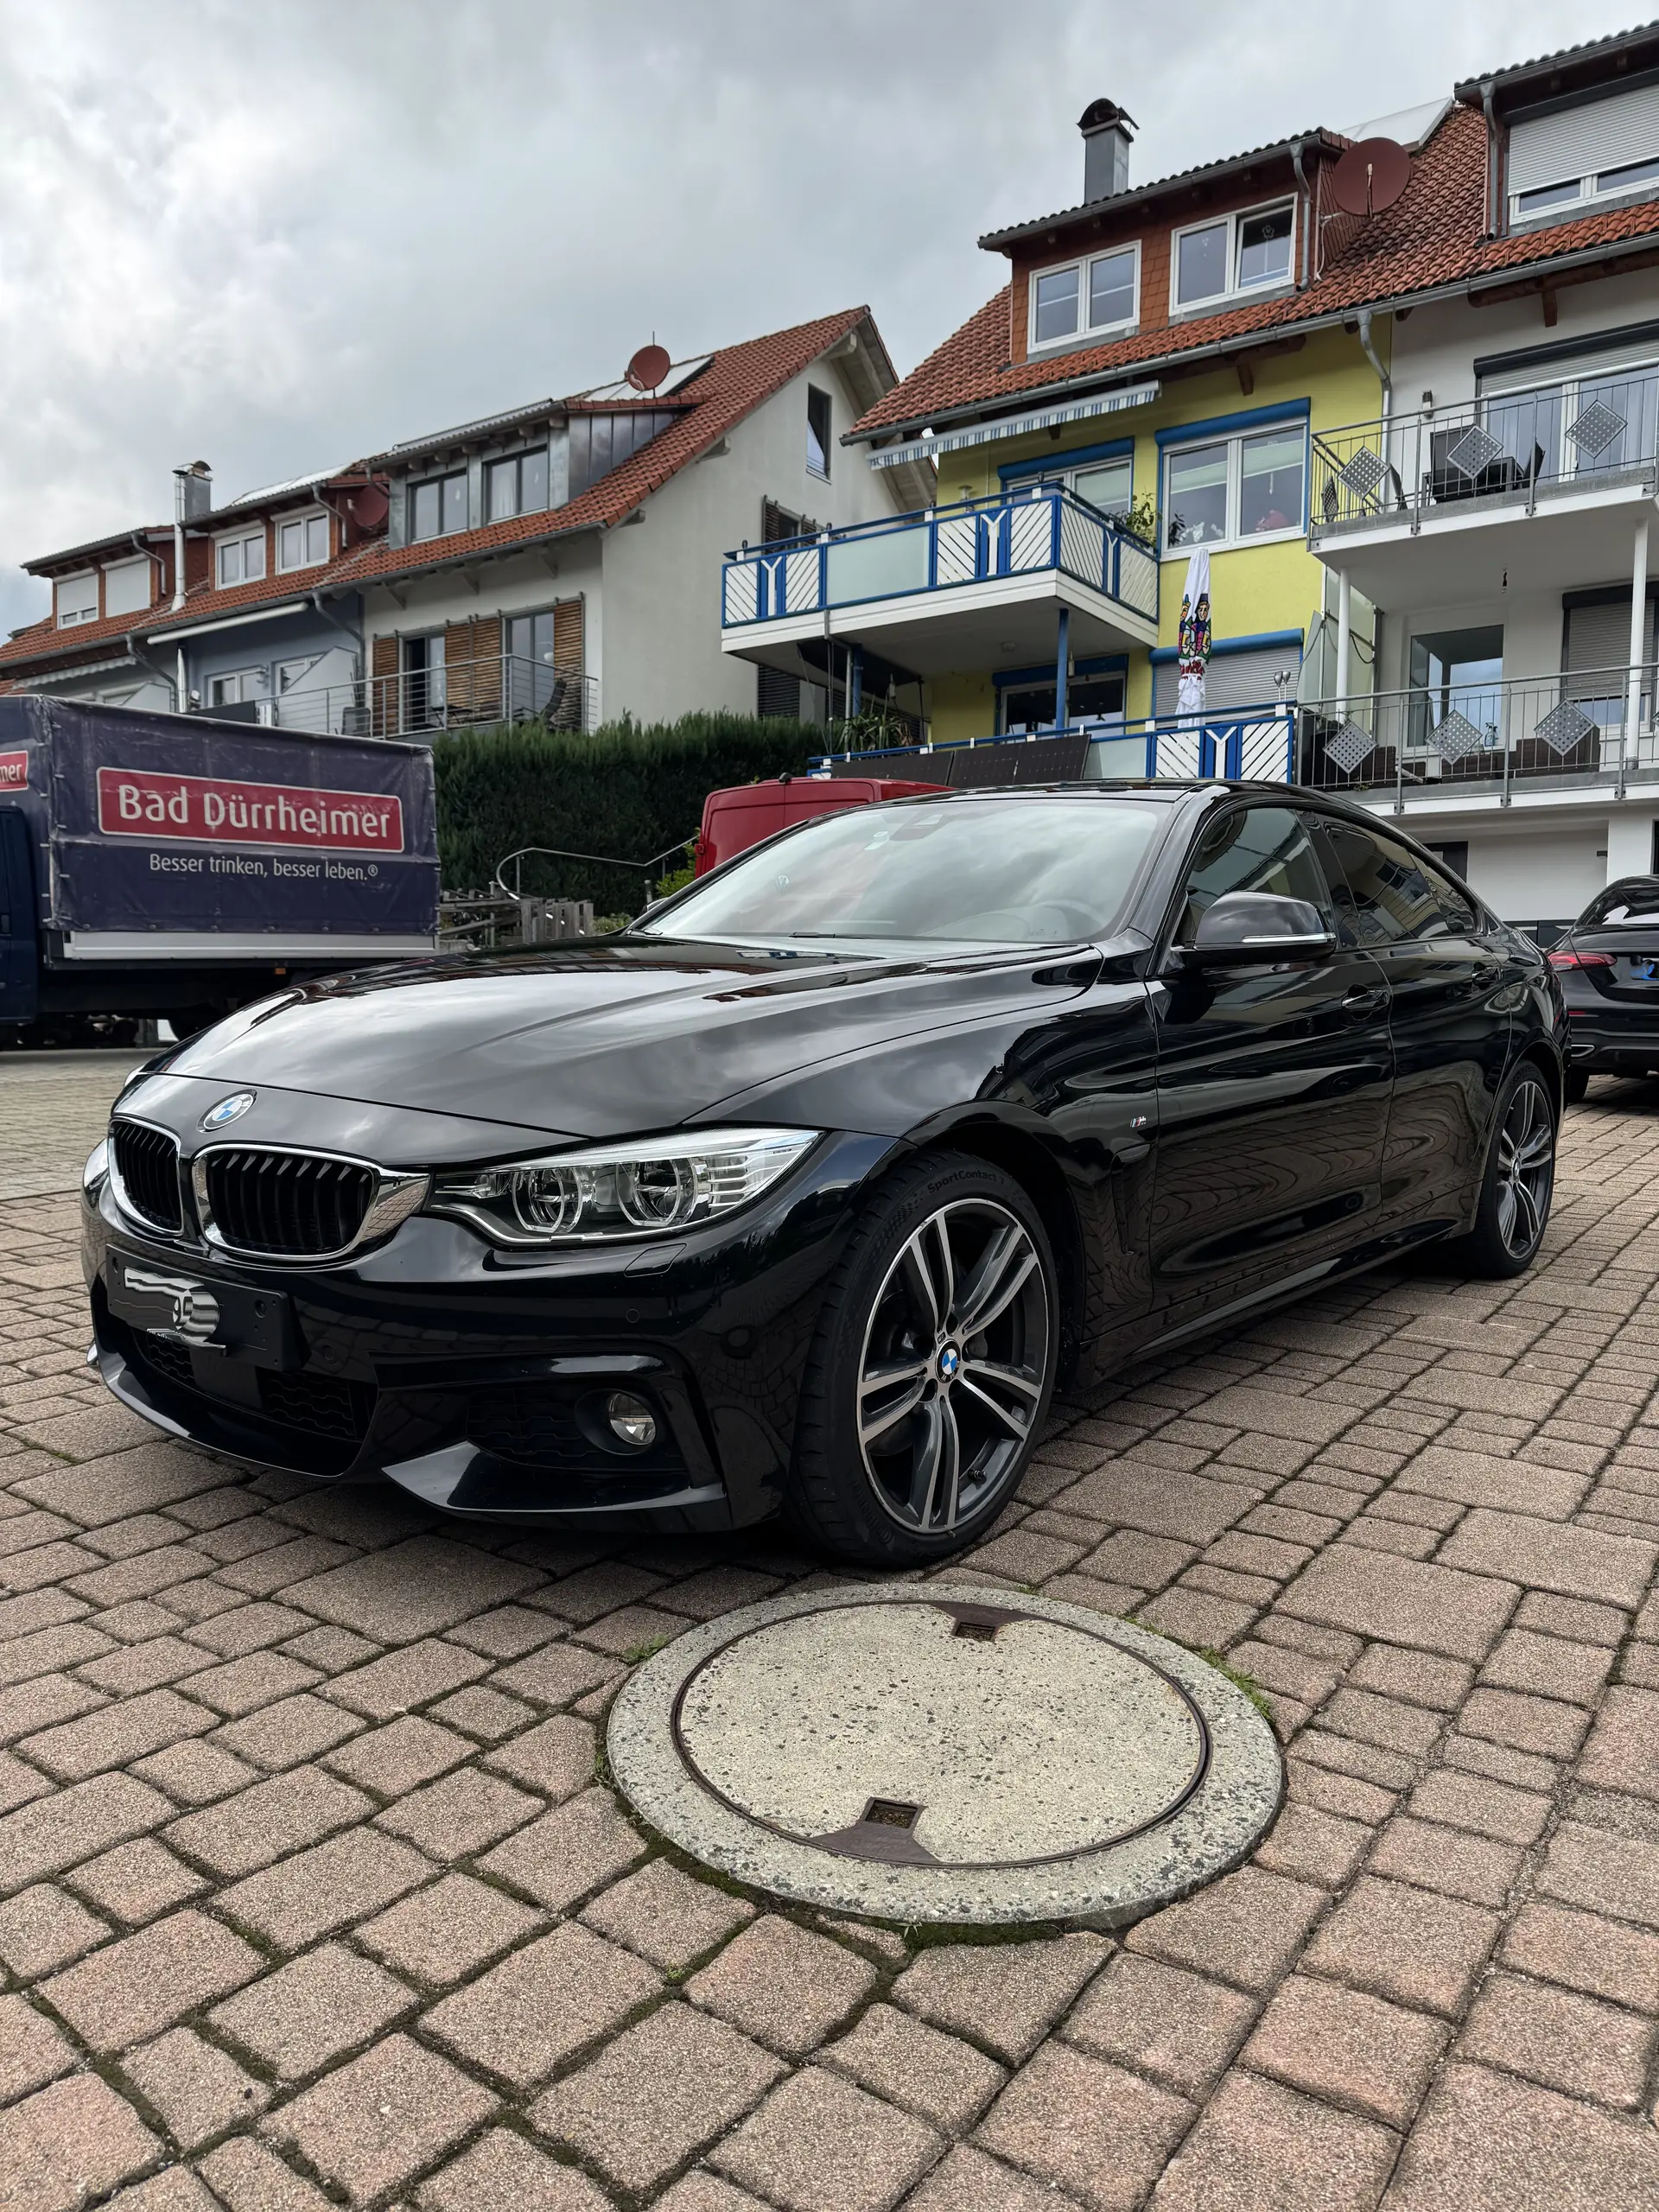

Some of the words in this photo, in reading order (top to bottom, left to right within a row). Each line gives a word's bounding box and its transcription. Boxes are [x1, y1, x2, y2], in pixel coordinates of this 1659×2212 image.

[118, 785, 188, 823] Bad
[203, 792, 391, 838] Dürrheimer
[149, 853, 204, 872] Besser
[209, 856, 268, 877] trinken,
[273, 858, 320, 878] besser
[927, 1170, 997, 1193] SportContact
